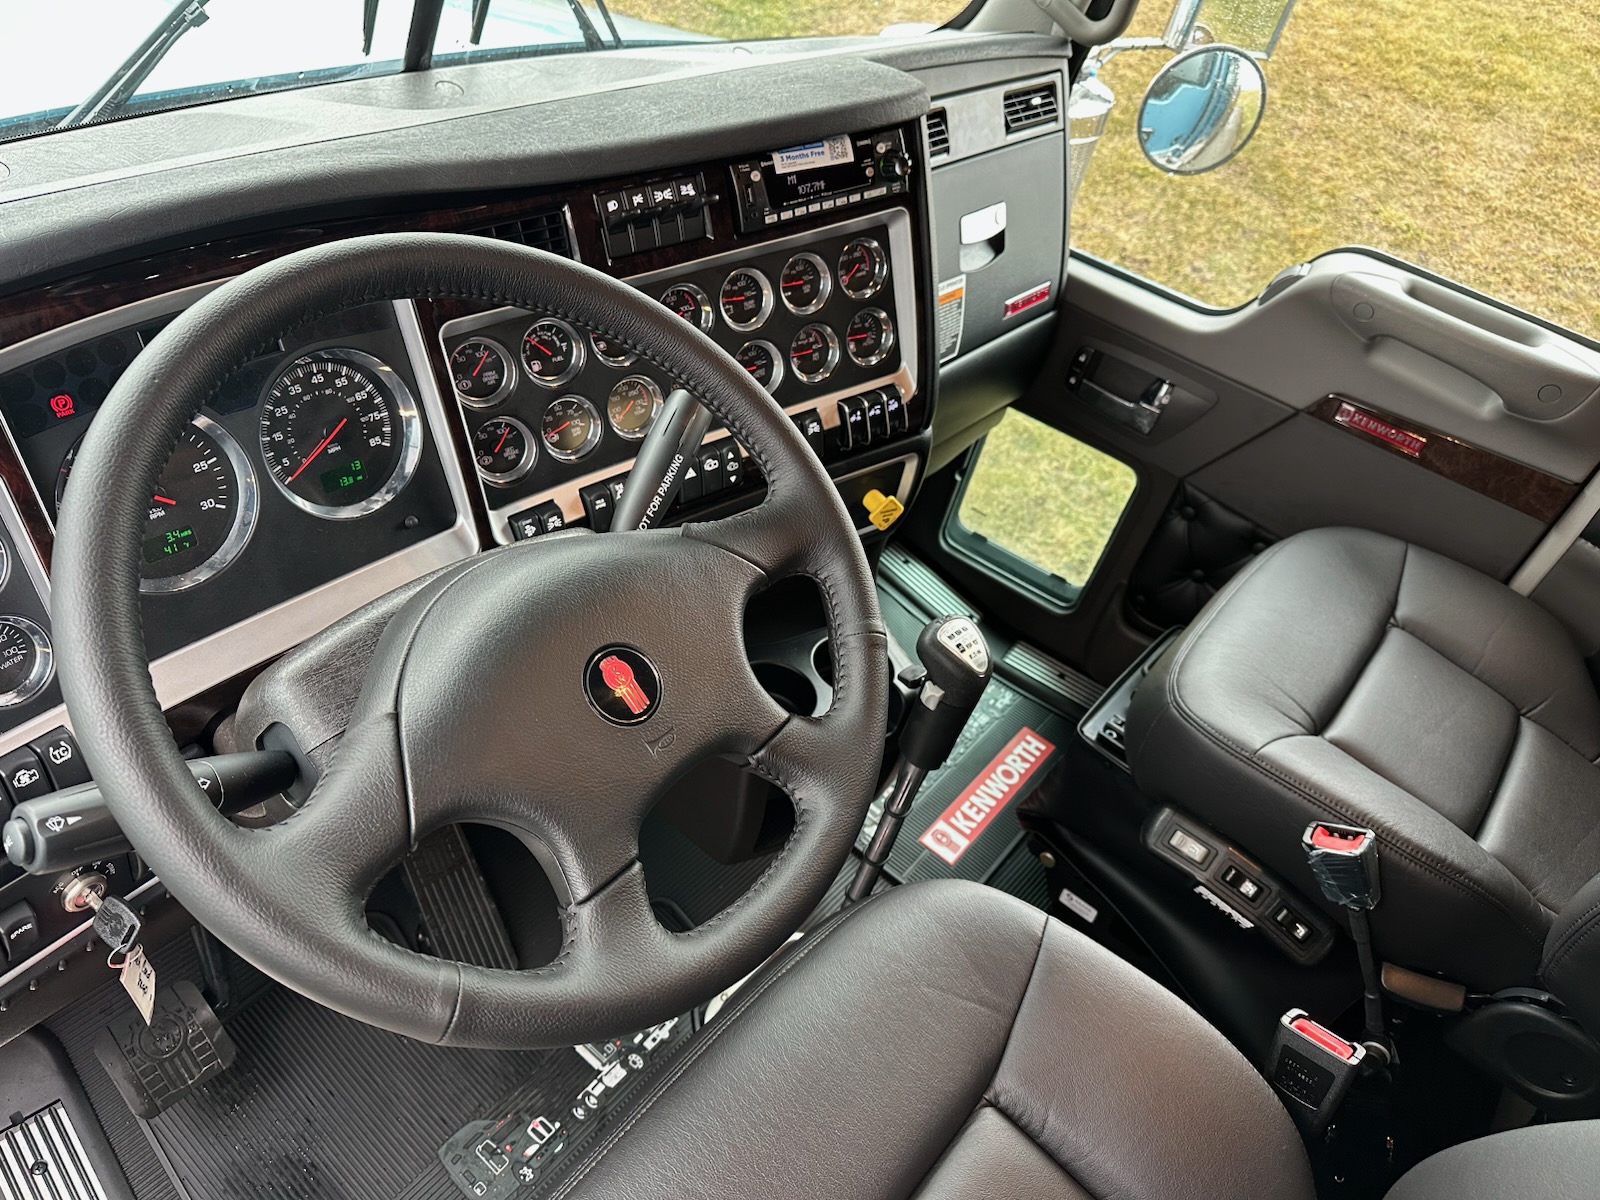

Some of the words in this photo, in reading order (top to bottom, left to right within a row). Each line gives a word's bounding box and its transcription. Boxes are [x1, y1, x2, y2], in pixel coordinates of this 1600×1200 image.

[785, 152, 810, 162] Months
[810, 150, 825, 158] Free
[311, 374, 324, 384] 45
[334, 377, 348, 387] 55
[288, 384, 302, 396] 35
[354, 391, 367, 401] 65
[56, 408, 75, 418] PARK
[274, 406, 288, 417] 25
[368, 412, 380, 422] 75
[272, 432, 283, 442] 15
[1352, 413, 1421, 450] KENWORTH
[369, 436, 382, 447] 85
[327, 446, 342, 454] MPH
[192, 462, 208, 473] 25
[282, 457, 290, 467] 5
[351, 460, 362, 471] 13
[637, 516, 650, 531] OT
[646, 495, 662, 517] FOR
[657, 454, 684, 496] PARKING
[200, 499, 215, 510] 30
[149, 510, 166, 520] RPM
[164, 544, 178, 554] 41
[0, 654, 24, 670] WATER
[52, 746, 67, 760] TC
[950, 734, 1048, 834] KENWORTH
[53, 882, 64, 894] ACC
[10, 922, 33, 940] SPARE
